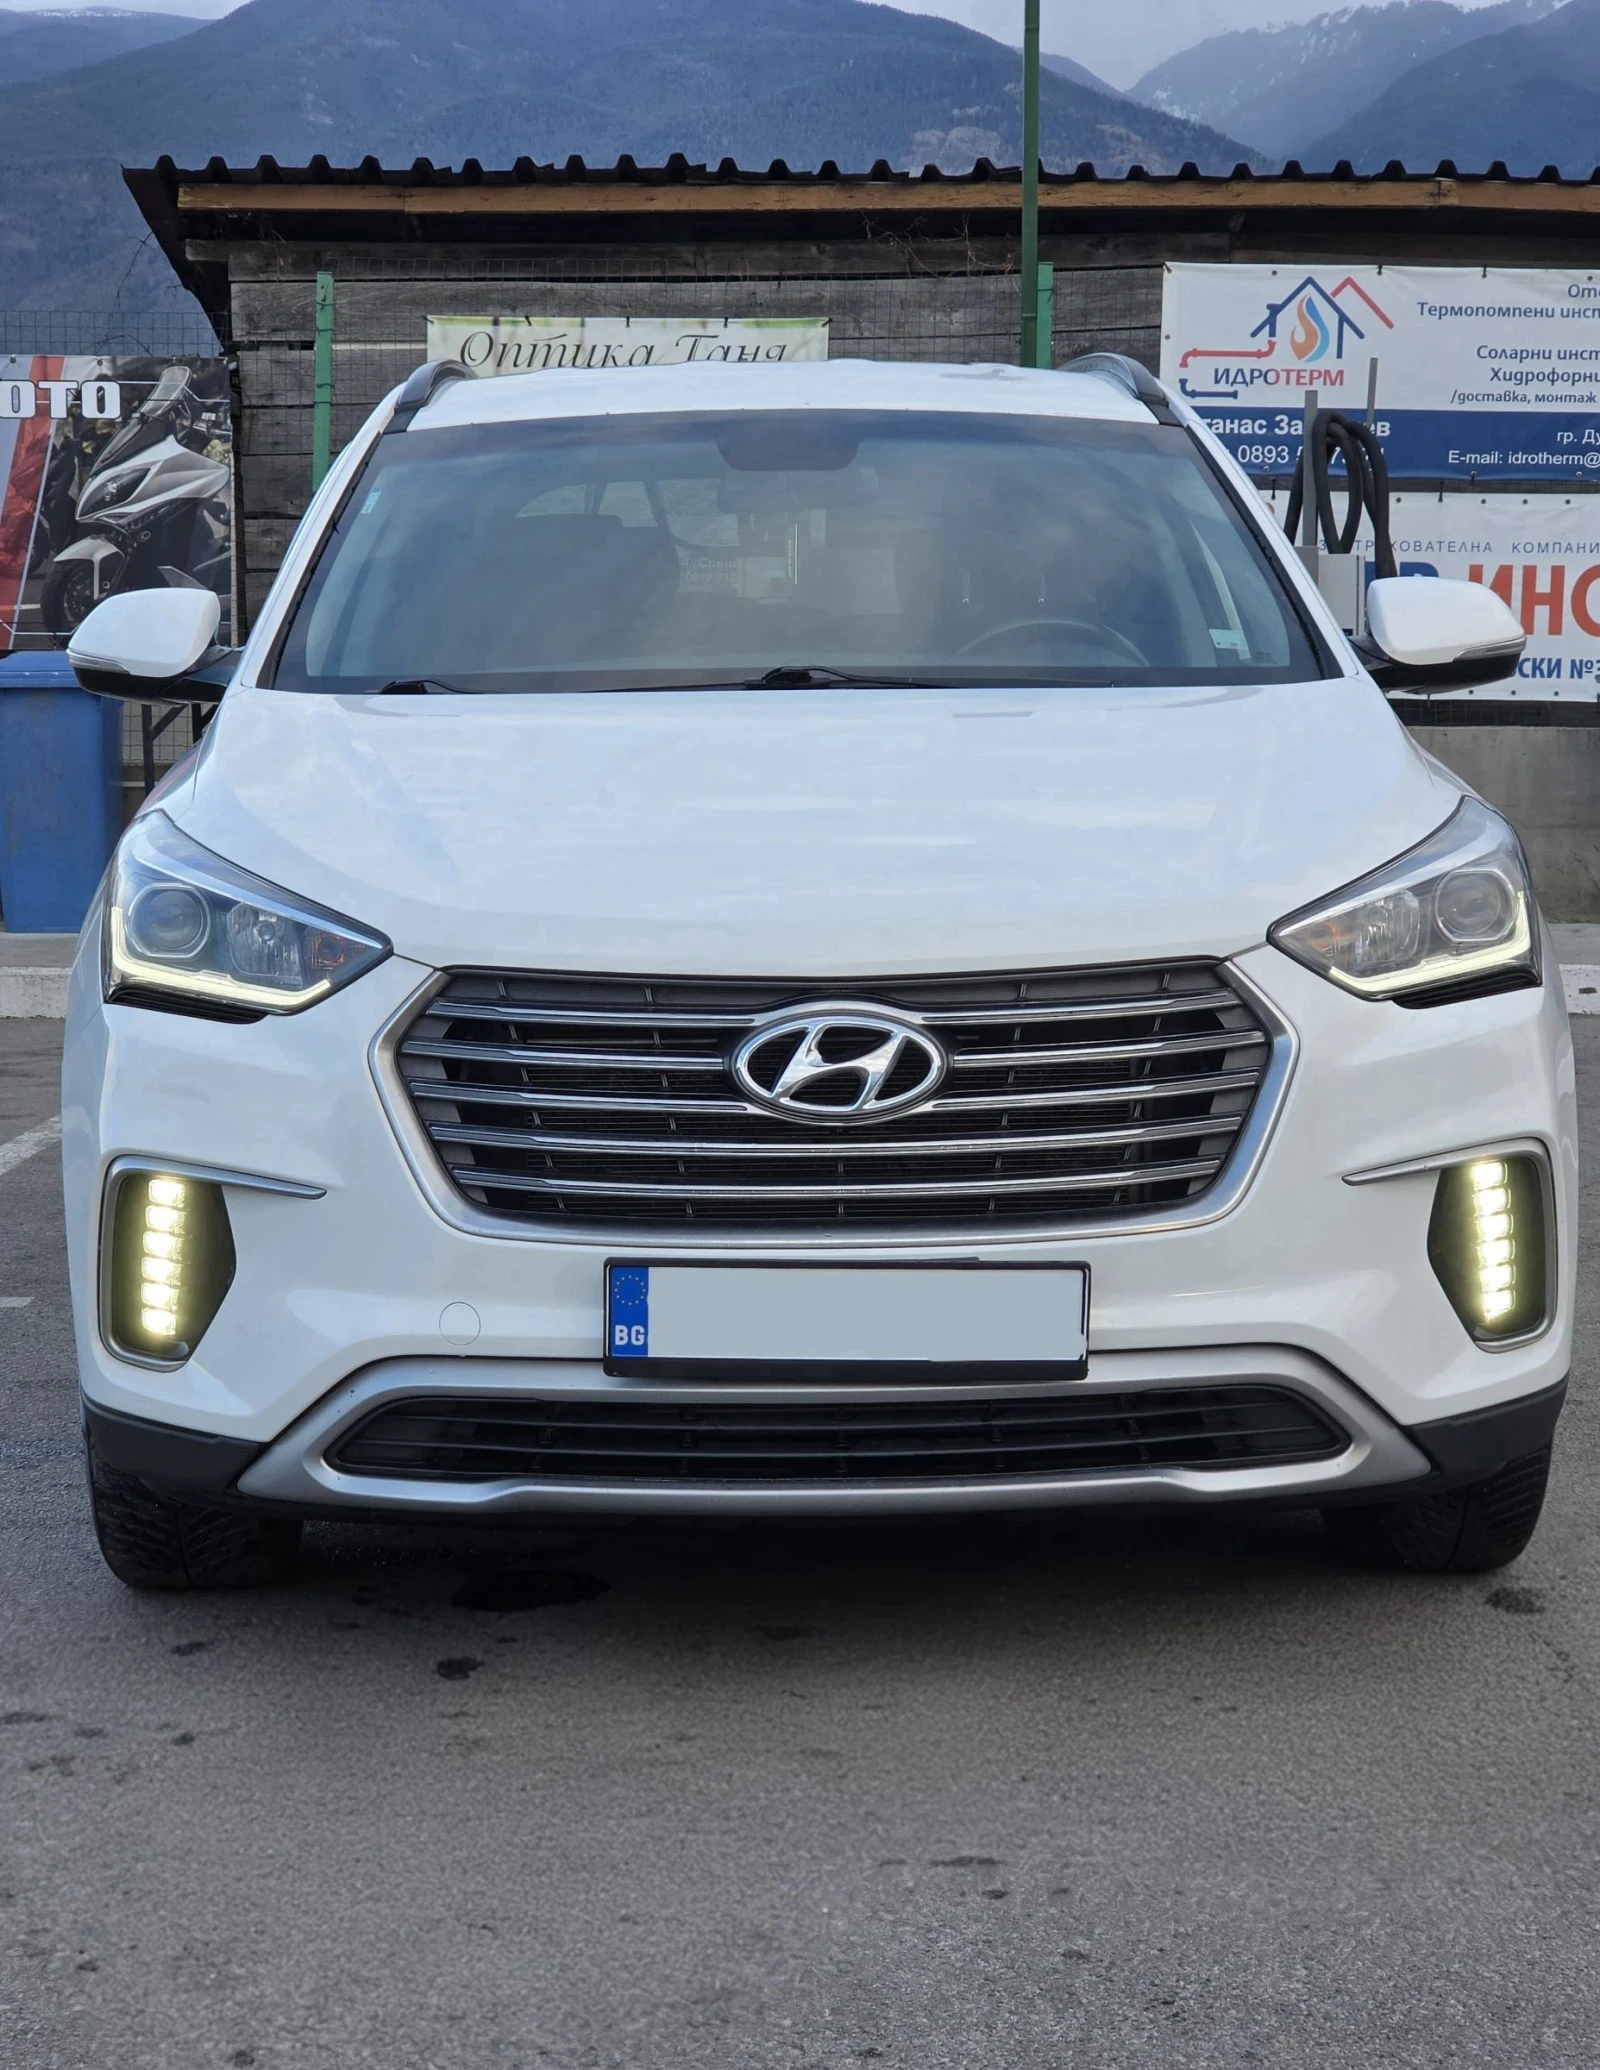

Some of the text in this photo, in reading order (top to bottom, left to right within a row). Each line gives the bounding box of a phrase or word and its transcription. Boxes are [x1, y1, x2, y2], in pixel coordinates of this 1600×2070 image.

[1567, 283, 1600, 299] От
[1416, 301, 1556, 321] Термопомпени
[1476, 344, 1553, 364] Соларни
[1213, 367, 1345, 387] ИДРОТЕРМ
[1450, 389, 1598, 405] /доставка, монтаж
[1556, 431, 1578, 445] гр.
[1237, 445, 1290, 464] 0893
[1448, 450, 1600, 469] E-mail: idrotherm@
[1511, 541, 1600, 554] КОМПАНИ
[615, 1325, 645, 1346] BG
